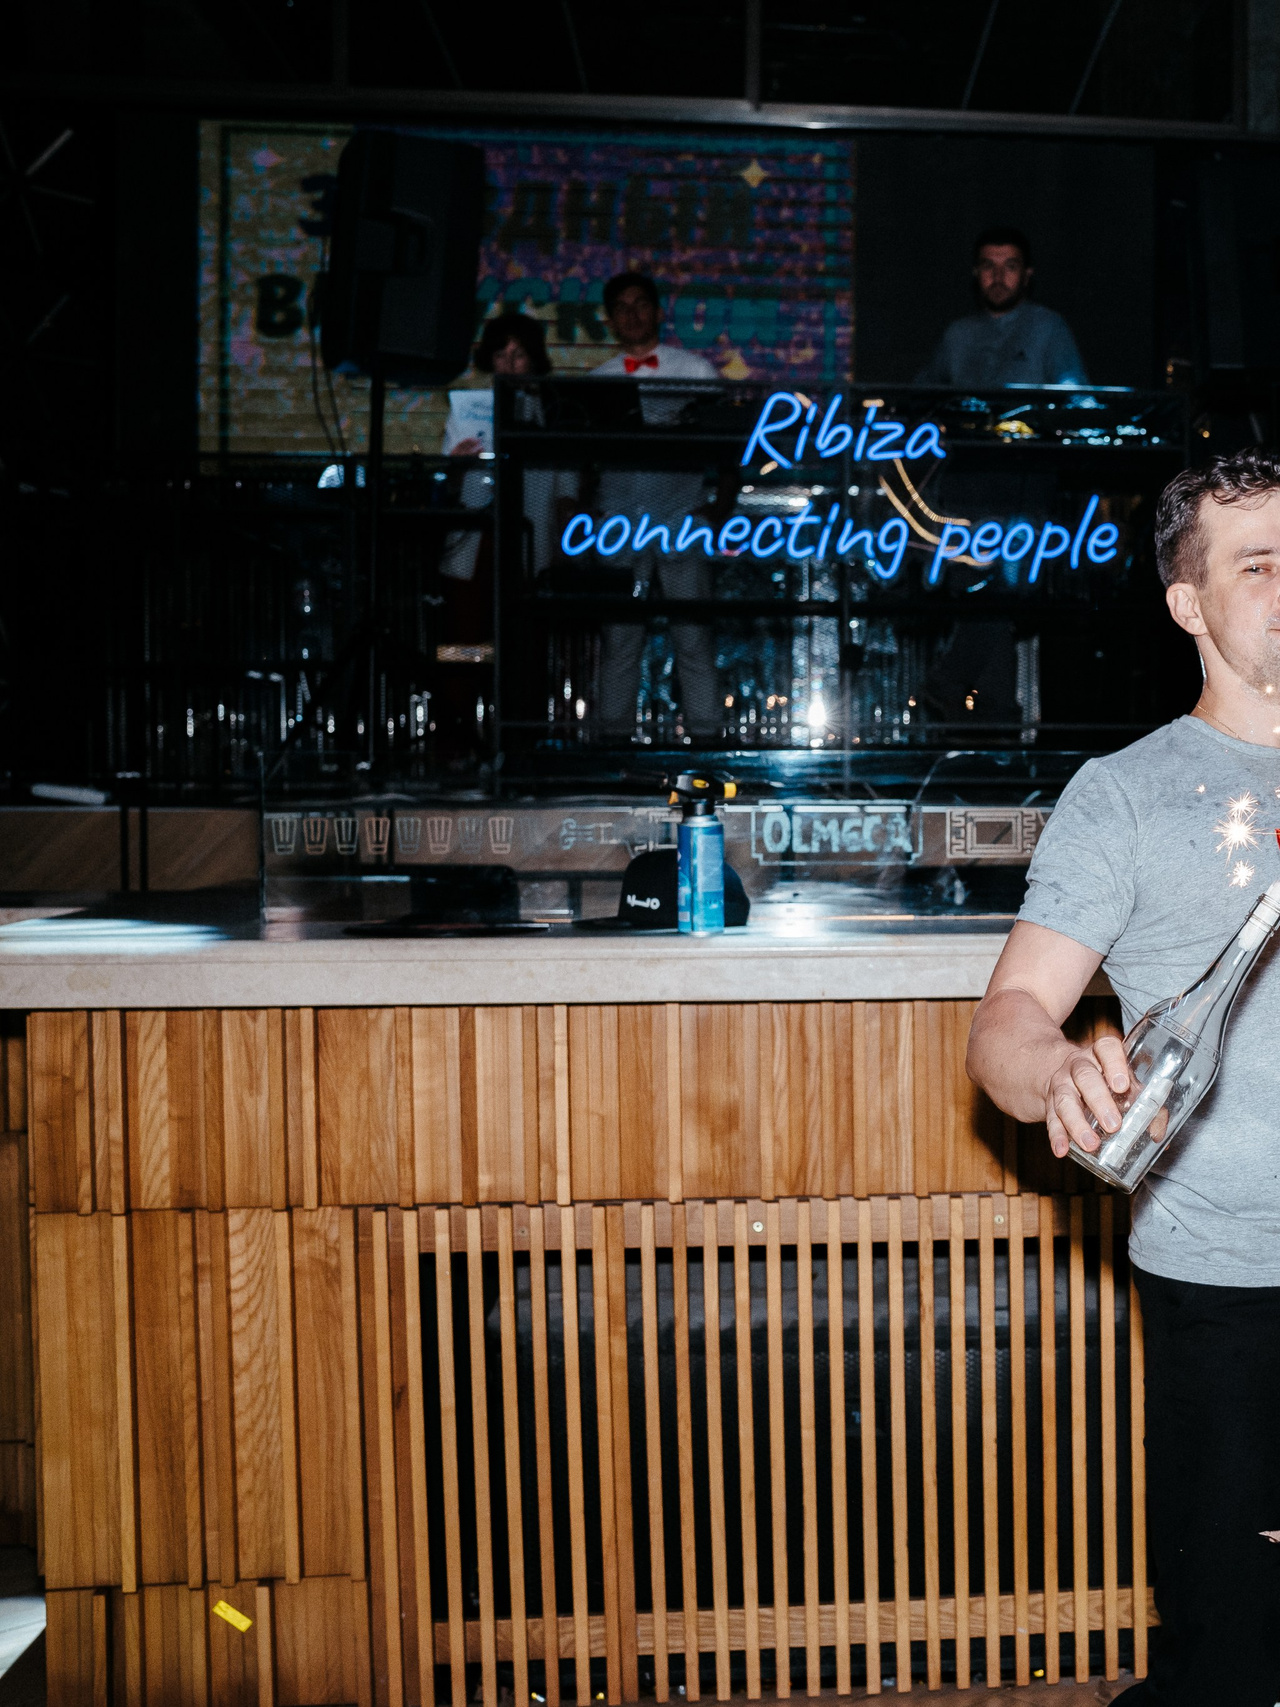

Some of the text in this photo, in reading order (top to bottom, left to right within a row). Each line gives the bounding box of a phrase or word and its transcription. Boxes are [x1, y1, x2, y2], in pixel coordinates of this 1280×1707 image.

[741, 392, 946, 469] Ribiza
[561, 494, 1120, 584] connecting people
